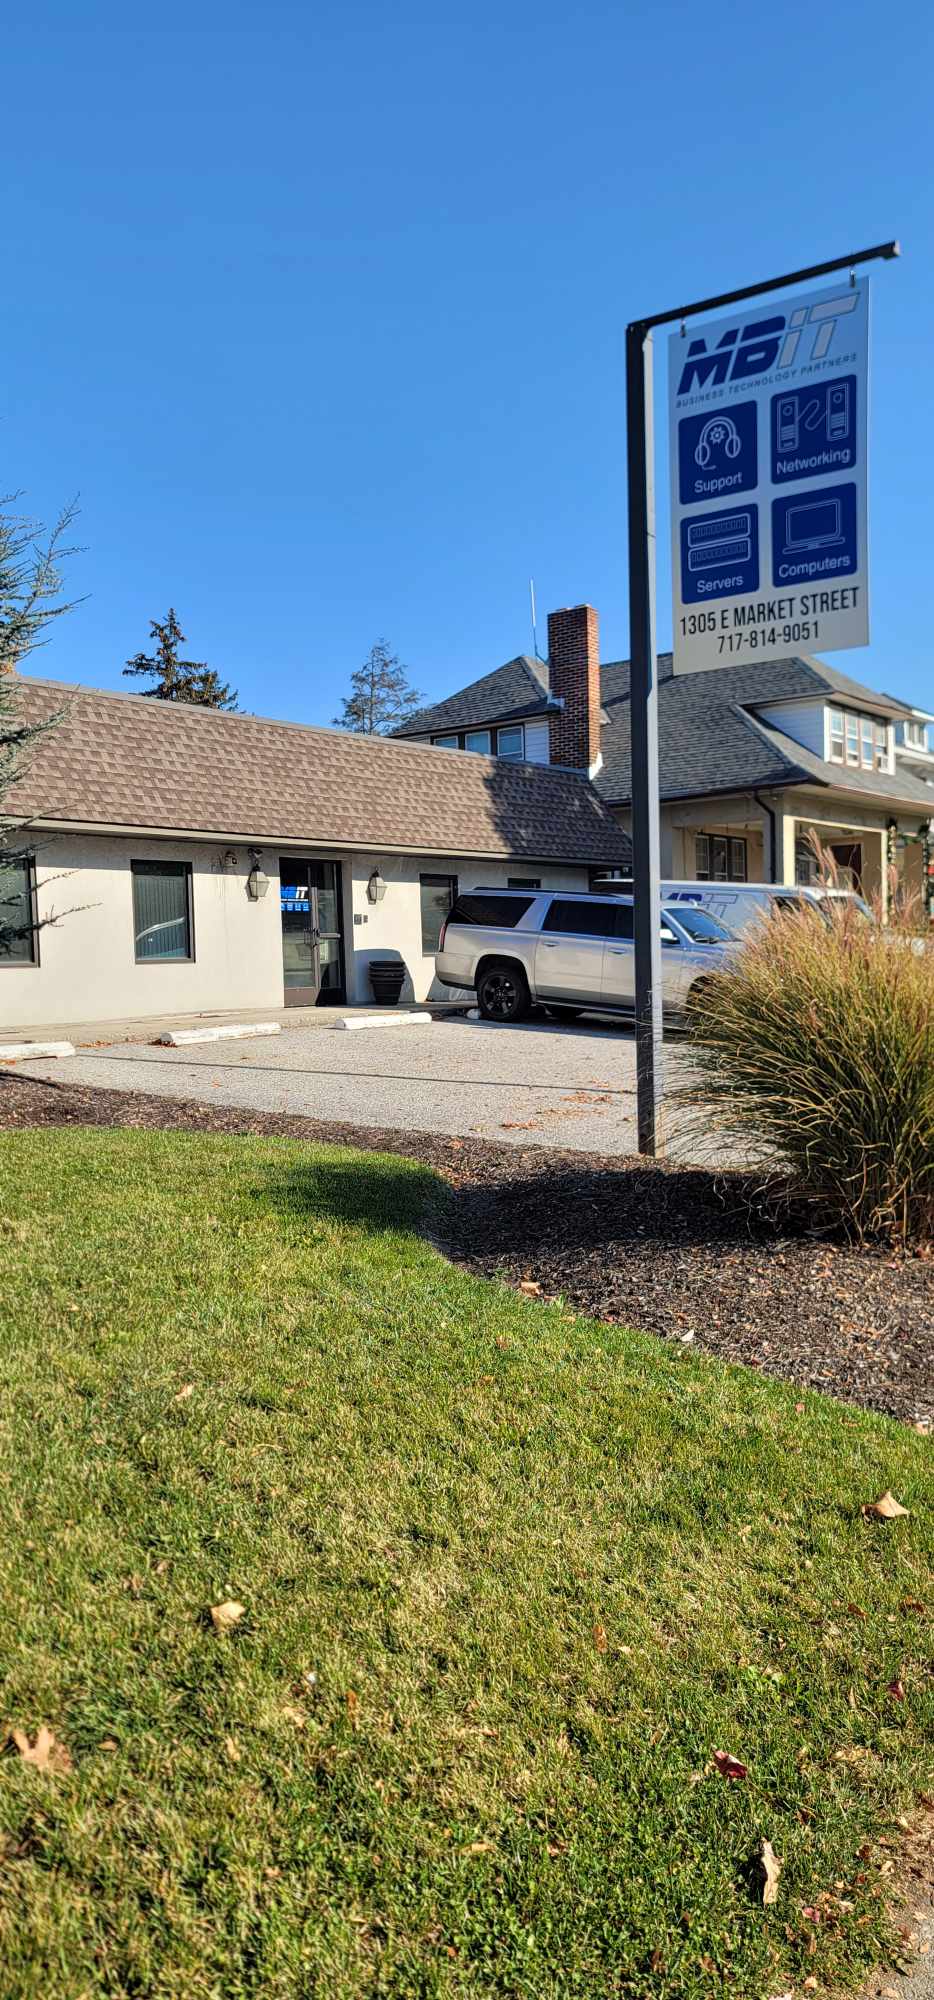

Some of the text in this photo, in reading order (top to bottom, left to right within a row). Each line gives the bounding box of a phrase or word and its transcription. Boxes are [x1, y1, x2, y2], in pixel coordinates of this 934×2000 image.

[676, 353, 857, 409] BUSINESS TECHNOLOGY PARTNERS
[776, 448, 851, 475] Networking
[694, 472, 742, 493] Support
[778, 555, 851, 578] Computers
[697, 575, 744, 593] Servers
[680, 586, 860, 636] 1305 E MARKET STREET
[717, 620, 819, 654] 717-814-9051
